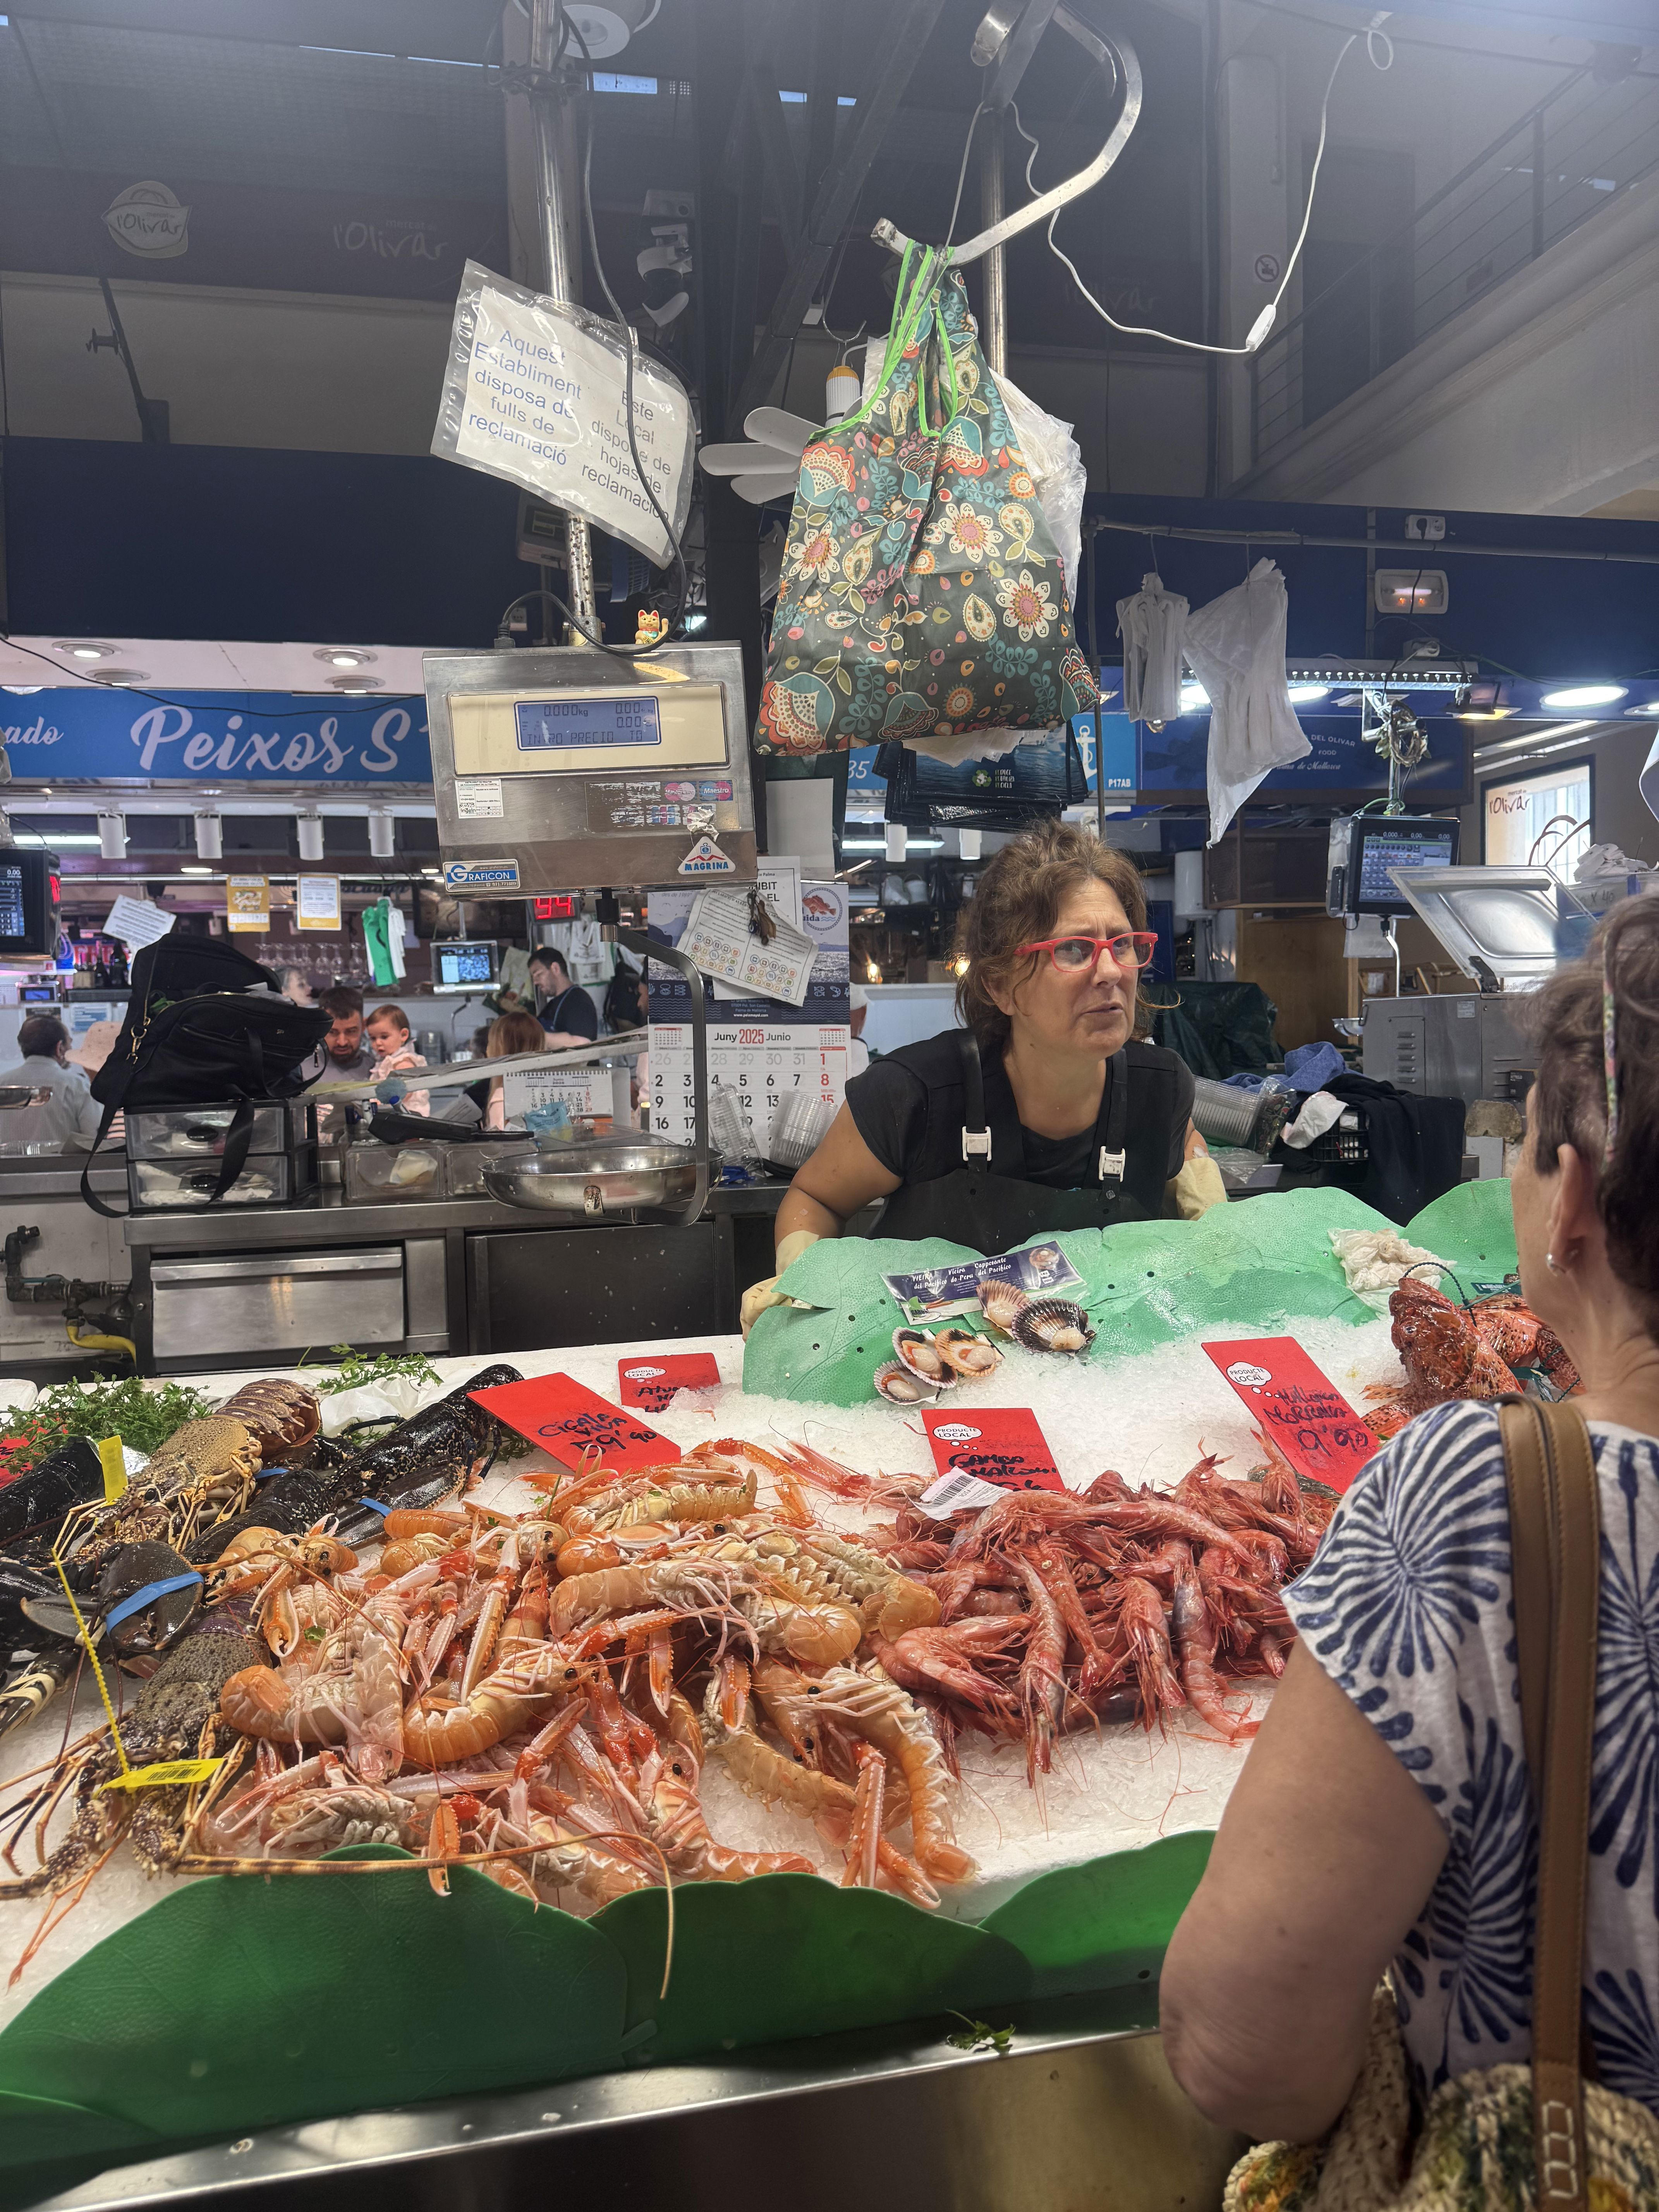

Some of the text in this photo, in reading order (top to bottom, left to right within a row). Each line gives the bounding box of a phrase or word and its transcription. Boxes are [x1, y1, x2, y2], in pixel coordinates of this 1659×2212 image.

[117, 213, 184, 235] l'Olivar
[333, 222, 448, 261] l'Olivar
[499, 330, 566, 367] Aquest
[474, 342, 582, 400] Establiment
[475, 369, 546, 410] disposa
[490, 396, 555, 436] fulls de
[468, 412, 567, 466] reclamació
[591, 420, 672, 476] dispoe de
[600, 446, 639, 481] hojas
[615, 702, 640, 714] 0.00
[130, 705, 355, 774] Peixos
[570, 731, 613, 744] PRECIO
[1328, 736, 1356, 747] OLIVAR
[1297, 761, 1306, 770] de
[1307, 761, 1341, 770] Mallorca
[1108, 778, 1132, 788] P17AB
[1489, 795, 1530, 814] l'Olivar
[450, 864, 510, 882] GRAFICON
[714, 1029, 791, 1044] Juny 2025 Junio
[654, 1053, 672, 1066] 26
[711, 1053, 728, 1066] 28
[738, 1053, 754, 1066] 29
[766, 1053, 783, 1066] 30
[793, 1053, 806, 1066] 31
[820, 1053, 826, 1066] 1
[655, 1073, 830, 1087] 2 3 4 5 6 7 8
[655, 1096, 664, 1108] 9
[766, 1095, 779, 1107] 13
[656, 1117, 696, 1130] 16 17
[1235, 1374, 1264, 1383] LOCAL
